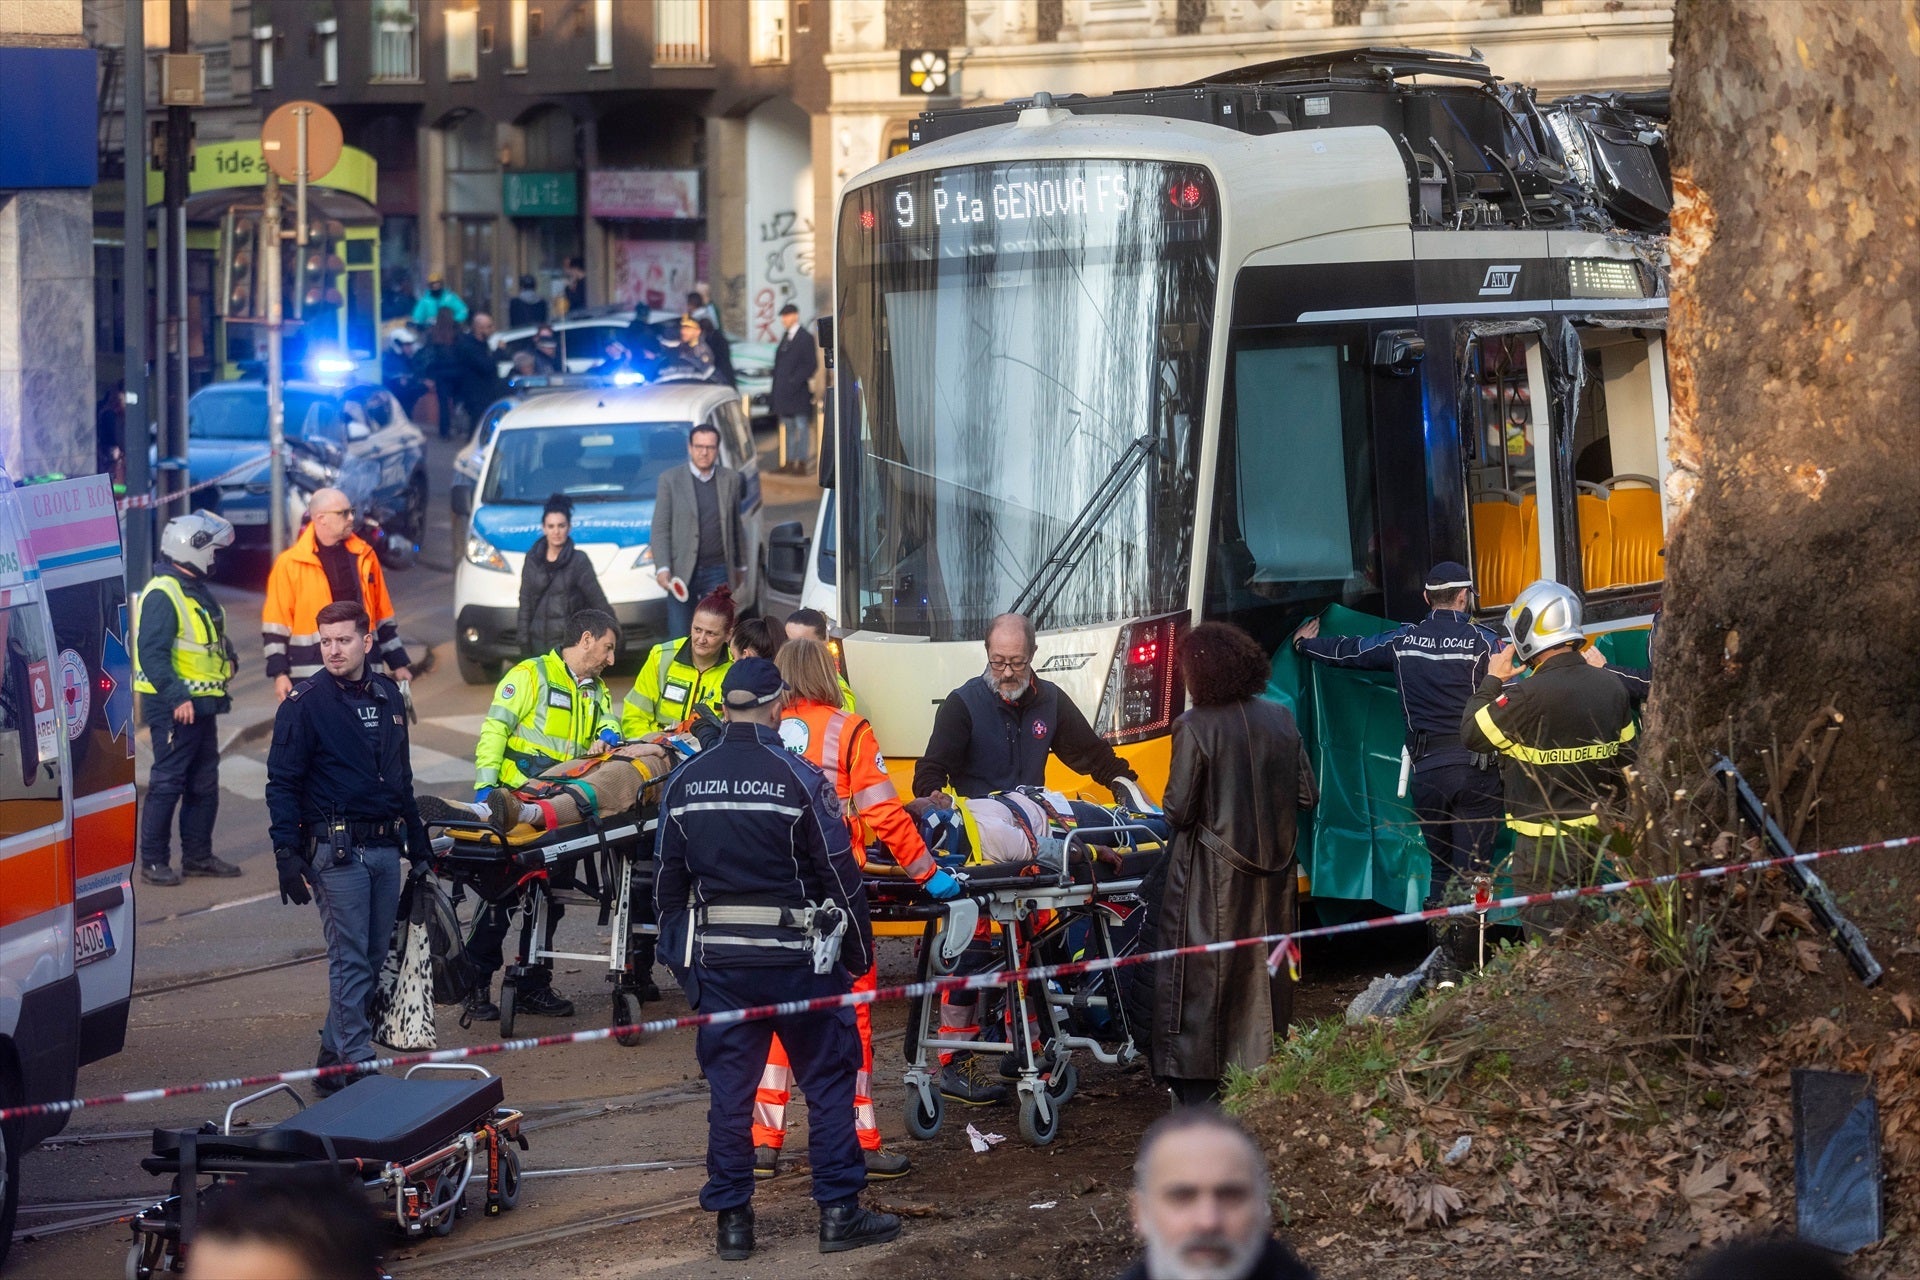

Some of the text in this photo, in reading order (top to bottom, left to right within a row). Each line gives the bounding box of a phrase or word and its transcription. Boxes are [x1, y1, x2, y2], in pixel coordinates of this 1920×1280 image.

[895, 174, 1129, 227] 9 P.ta GENOVA FS
[1491, 273, 1509, 287] ATM
[33, 488, 81, 518] CROCE
[0, 552, 19, 575] PAS
[1440, 637, 1475, 649] LOCALE
[37, 720, 56, 737] AREU
[1539, 750, 1572, 763] VIGILI
[1575, 748, 1593, 761] DEL
[685, 780, 786, 798] POLIZIA LOCALE
